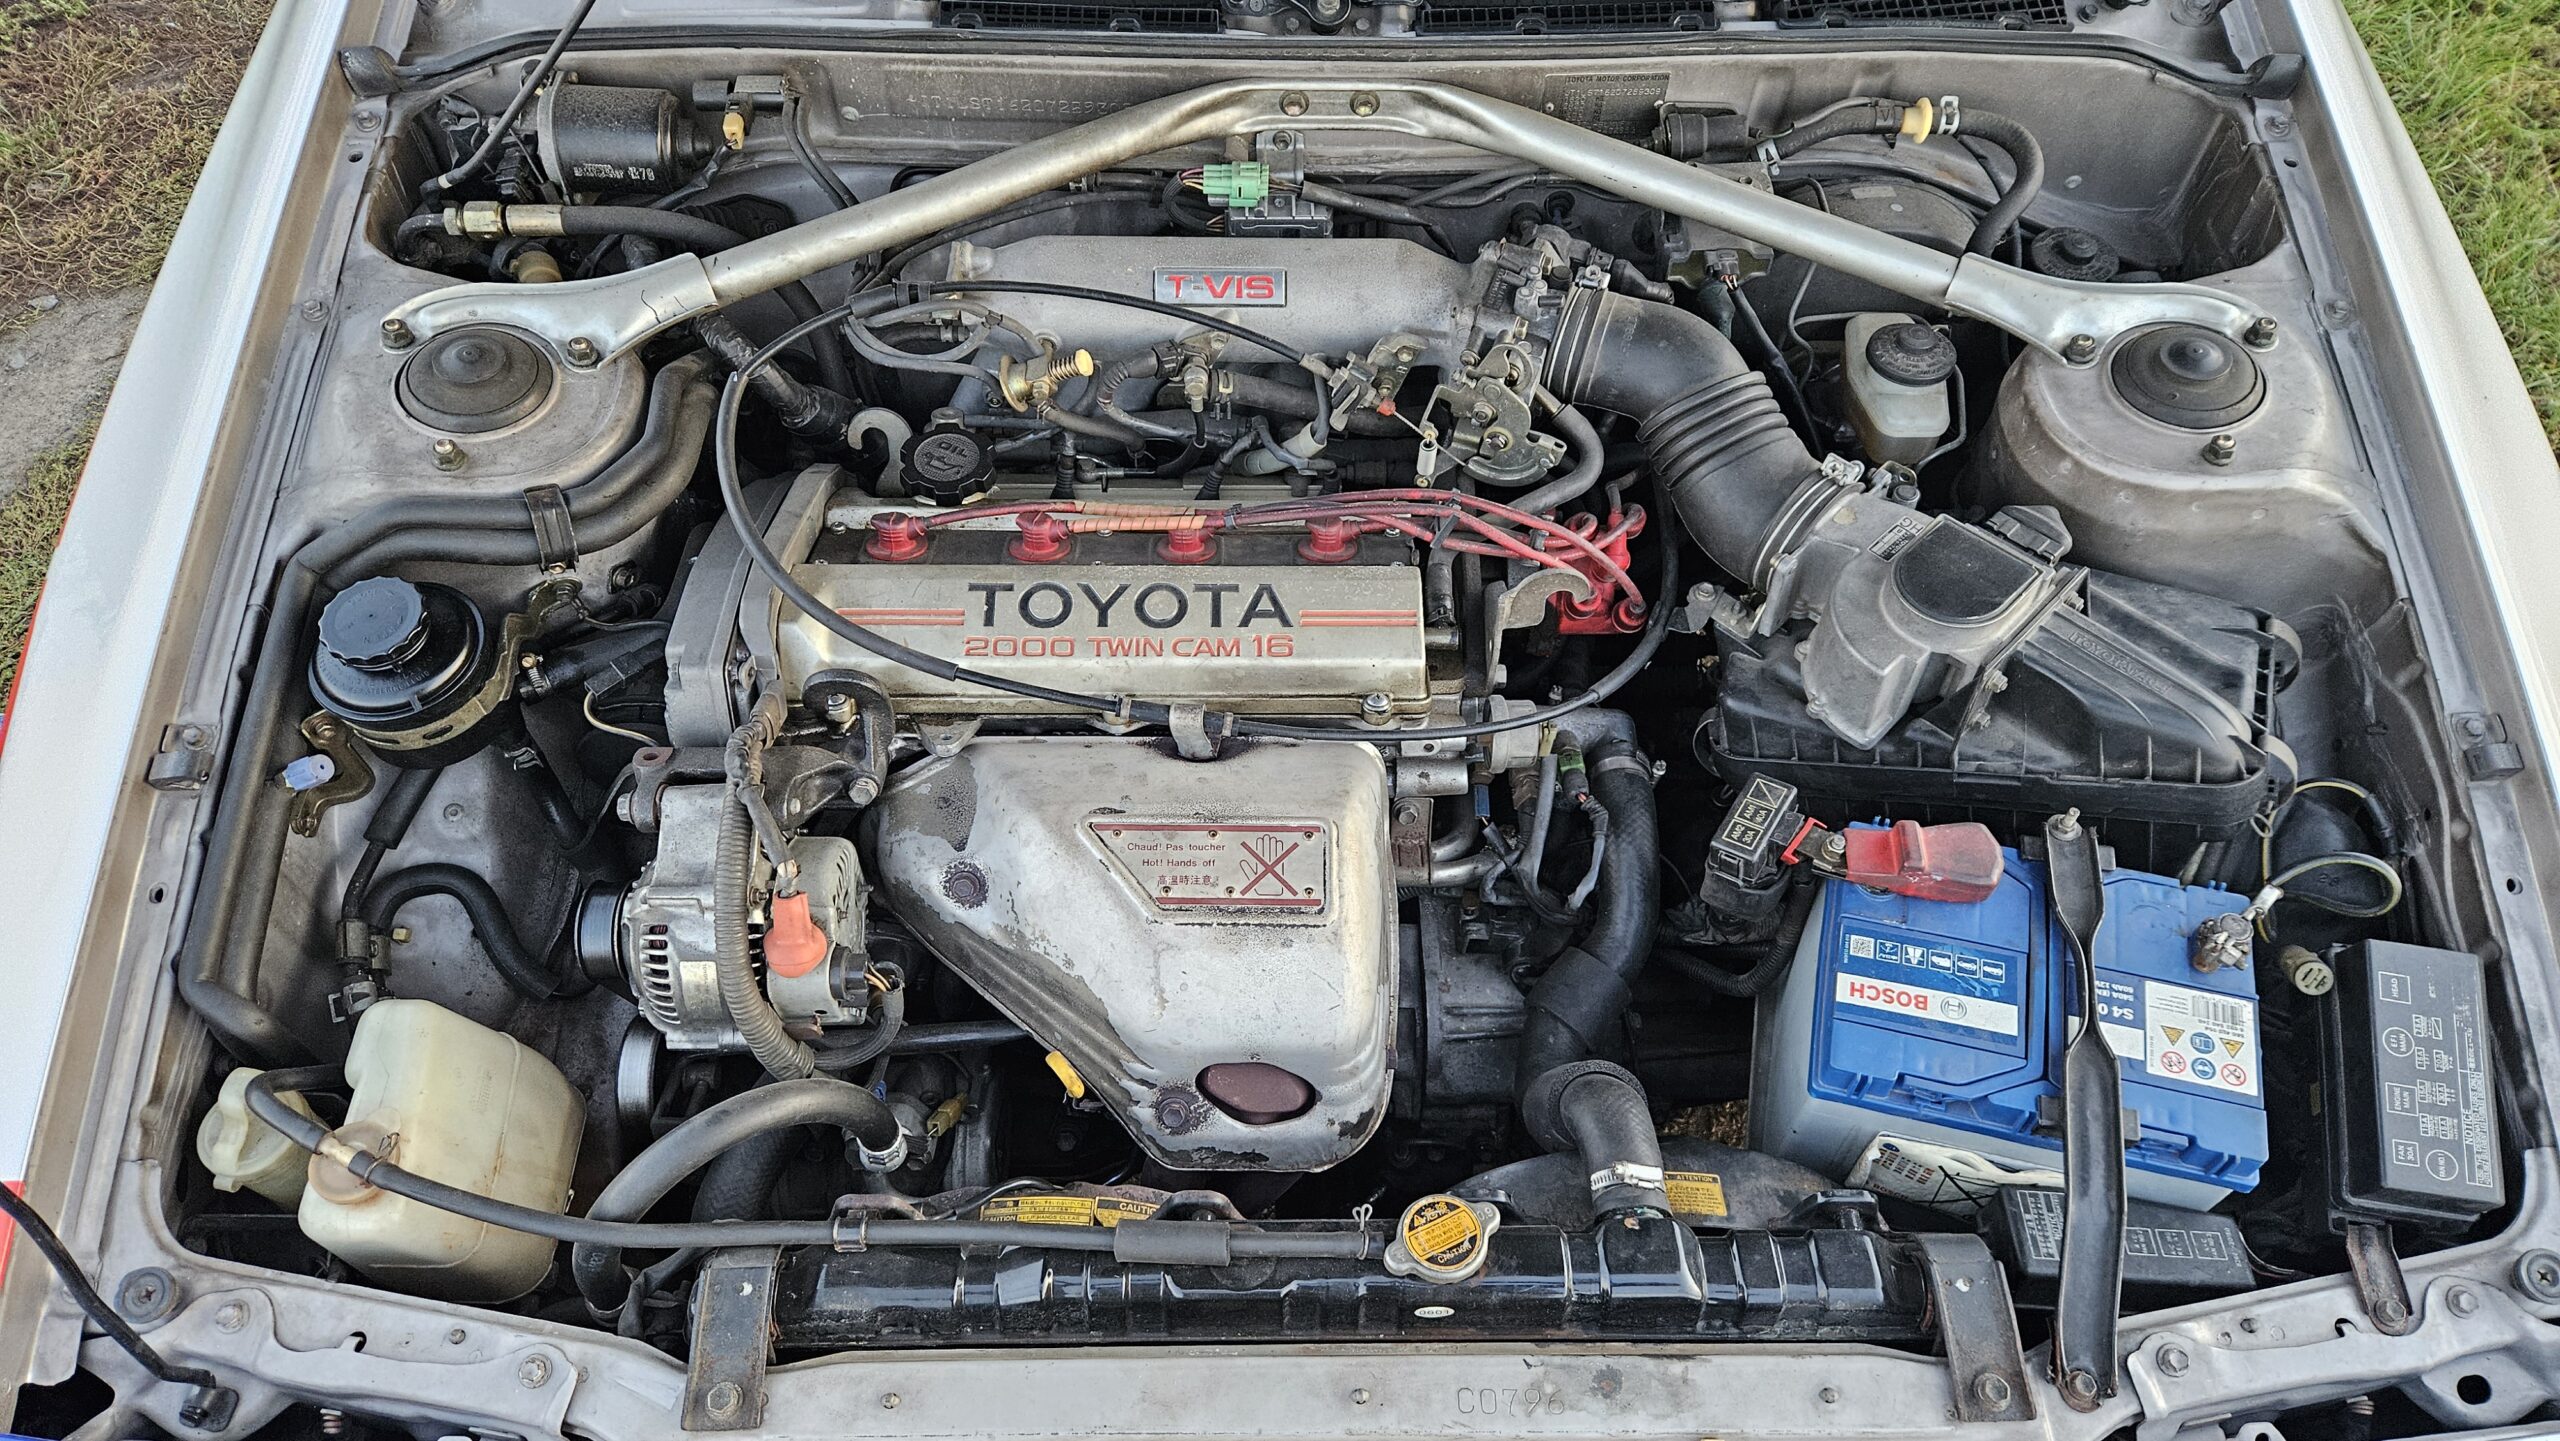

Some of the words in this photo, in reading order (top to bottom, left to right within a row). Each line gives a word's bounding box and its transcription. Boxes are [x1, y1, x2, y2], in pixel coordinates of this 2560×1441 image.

[1596, 75, 1620, 83] MOTOR
[1622, 74, 1670, 82] CORPORATION
[1164, 275, 1275, 299] T-VIS
[940, 441, 967, 458] OIL
[968, 582, 1294, 629] TOYOTA
[964, 636, 1075, 657] 2000
[1087, 637, 1164, 657] TWIN
[1171, 637, 1241, 657] CAM
[1251, 634, 1295, 657] 16
[1743, 804, 1757, 819] AM1
[1731, 824, 1746, 840] AM2
[1127, 843, 1162, 851] Chaud!
[1189, 843, 1226, 851] toucher
[1142, 859, 1163, 867] Hot!
[1167, 859, 1198, 867] Hands
[1202, 859, 1216, 867] off
[1849, 981, 1928, 1011] BOSCH
[2391, 978, 2399, 998] HEAD
[2111, 1005, 2135, 1021] S4
[2390, 1034, 2398, 1048] EFI
[2399, 1033, 2407, 1052] MAIN
[2393, 1086, 2402, 1110] ENGINE
[2402, 1091, 2410, 1109] MAIN
[2463, 1108, 2474, 1145] NOTICE
[2407, 1146, 2415, 1161] 30A
[1676, 1174, 1713, 1182] ATTENTION
[1872, 1183, 1909, 1200] BOSCH
[984, 1215, 1016, 1223] CAUTION
[1437, 1240, 1472, 1264] CAUTION
